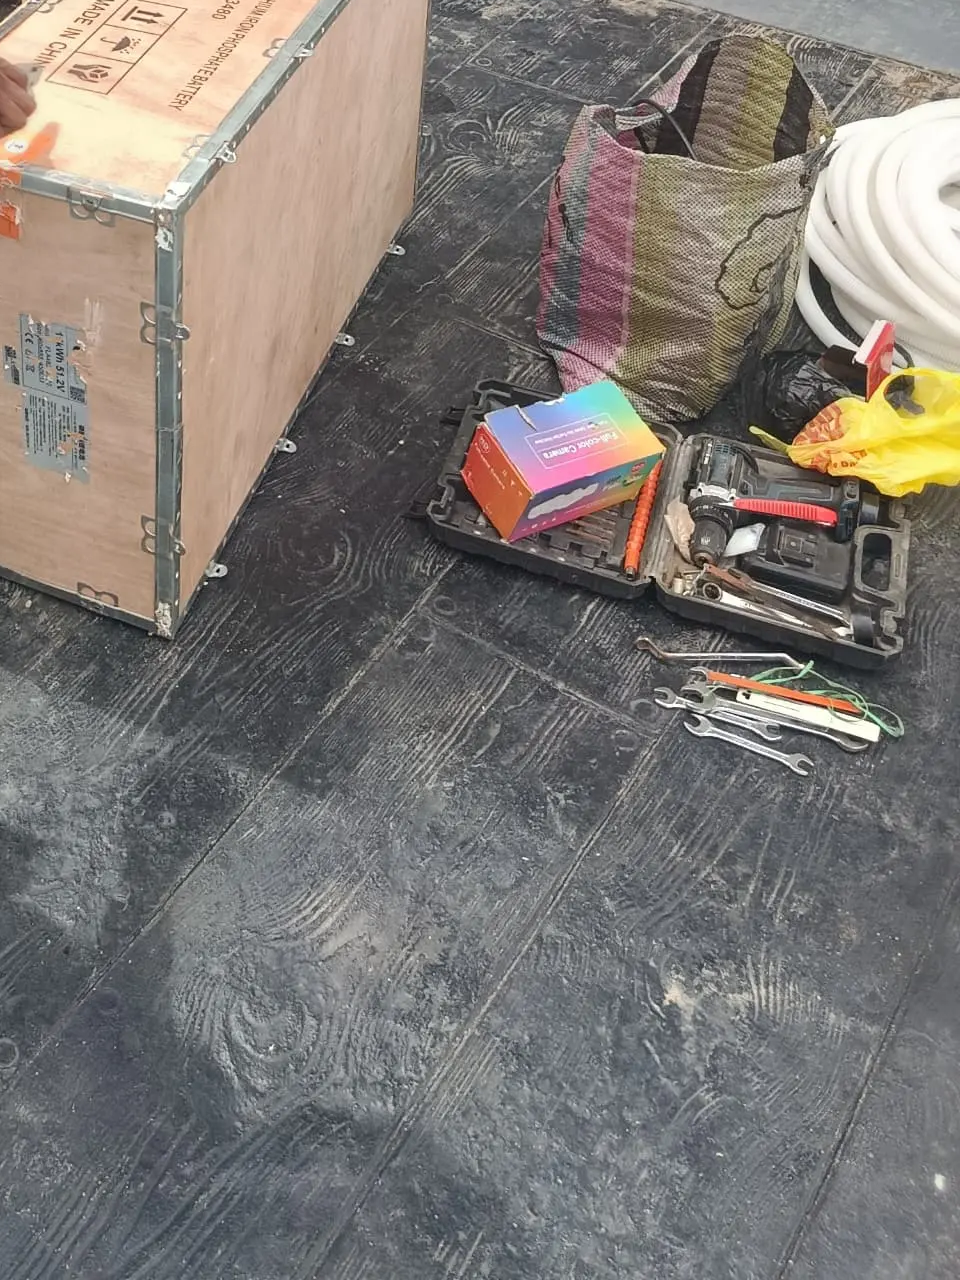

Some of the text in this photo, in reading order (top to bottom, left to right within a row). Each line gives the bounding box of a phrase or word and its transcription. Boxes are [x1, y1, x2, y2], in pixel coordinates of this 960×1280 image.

[59, 27, 83, 39] IN
[234, 16, 261, 34] IRON
[196, 32, 246, 78] PHOSPHATE
[168, 75, 209, 111] BATTERY
[542, 442, 577, 460] Camera
